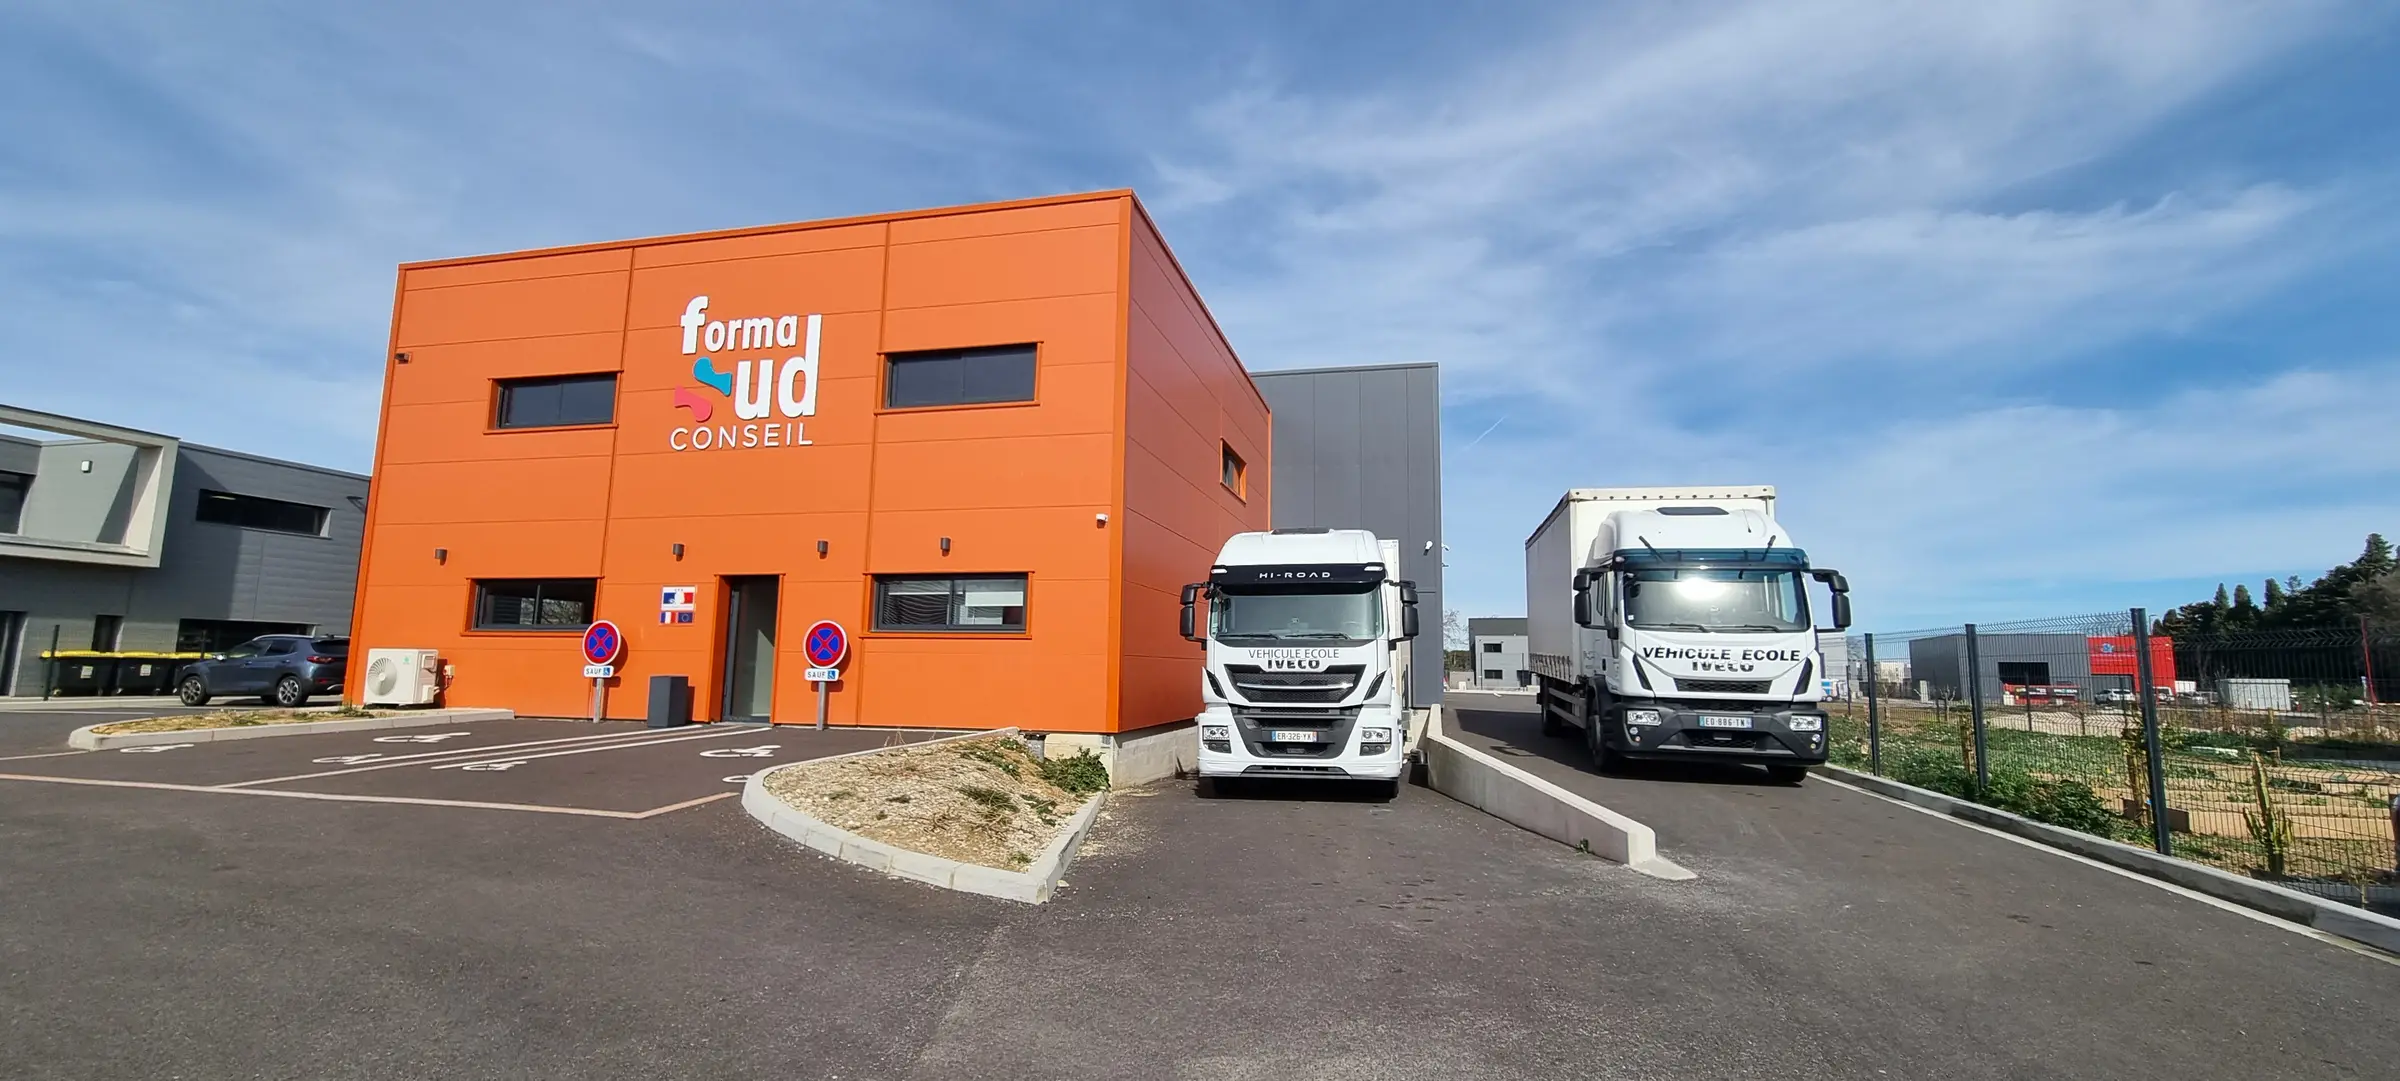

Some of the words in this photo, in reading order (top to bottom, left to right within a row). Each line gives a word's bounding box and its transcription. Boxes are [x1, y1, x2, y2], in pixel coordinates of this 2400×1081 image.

[680, 295, 798, 354] forma
[670, 422, 813, 450] CONSEIL
[1248, 648, 1301, 659] VEHICULE
[1304, 648, 1340, 659] ECOLE
[1267, 659, 1320, 670] IVECO
[1692, 660, 1755, 673] IVECO
[807, 671, 826, 679] SAUF
